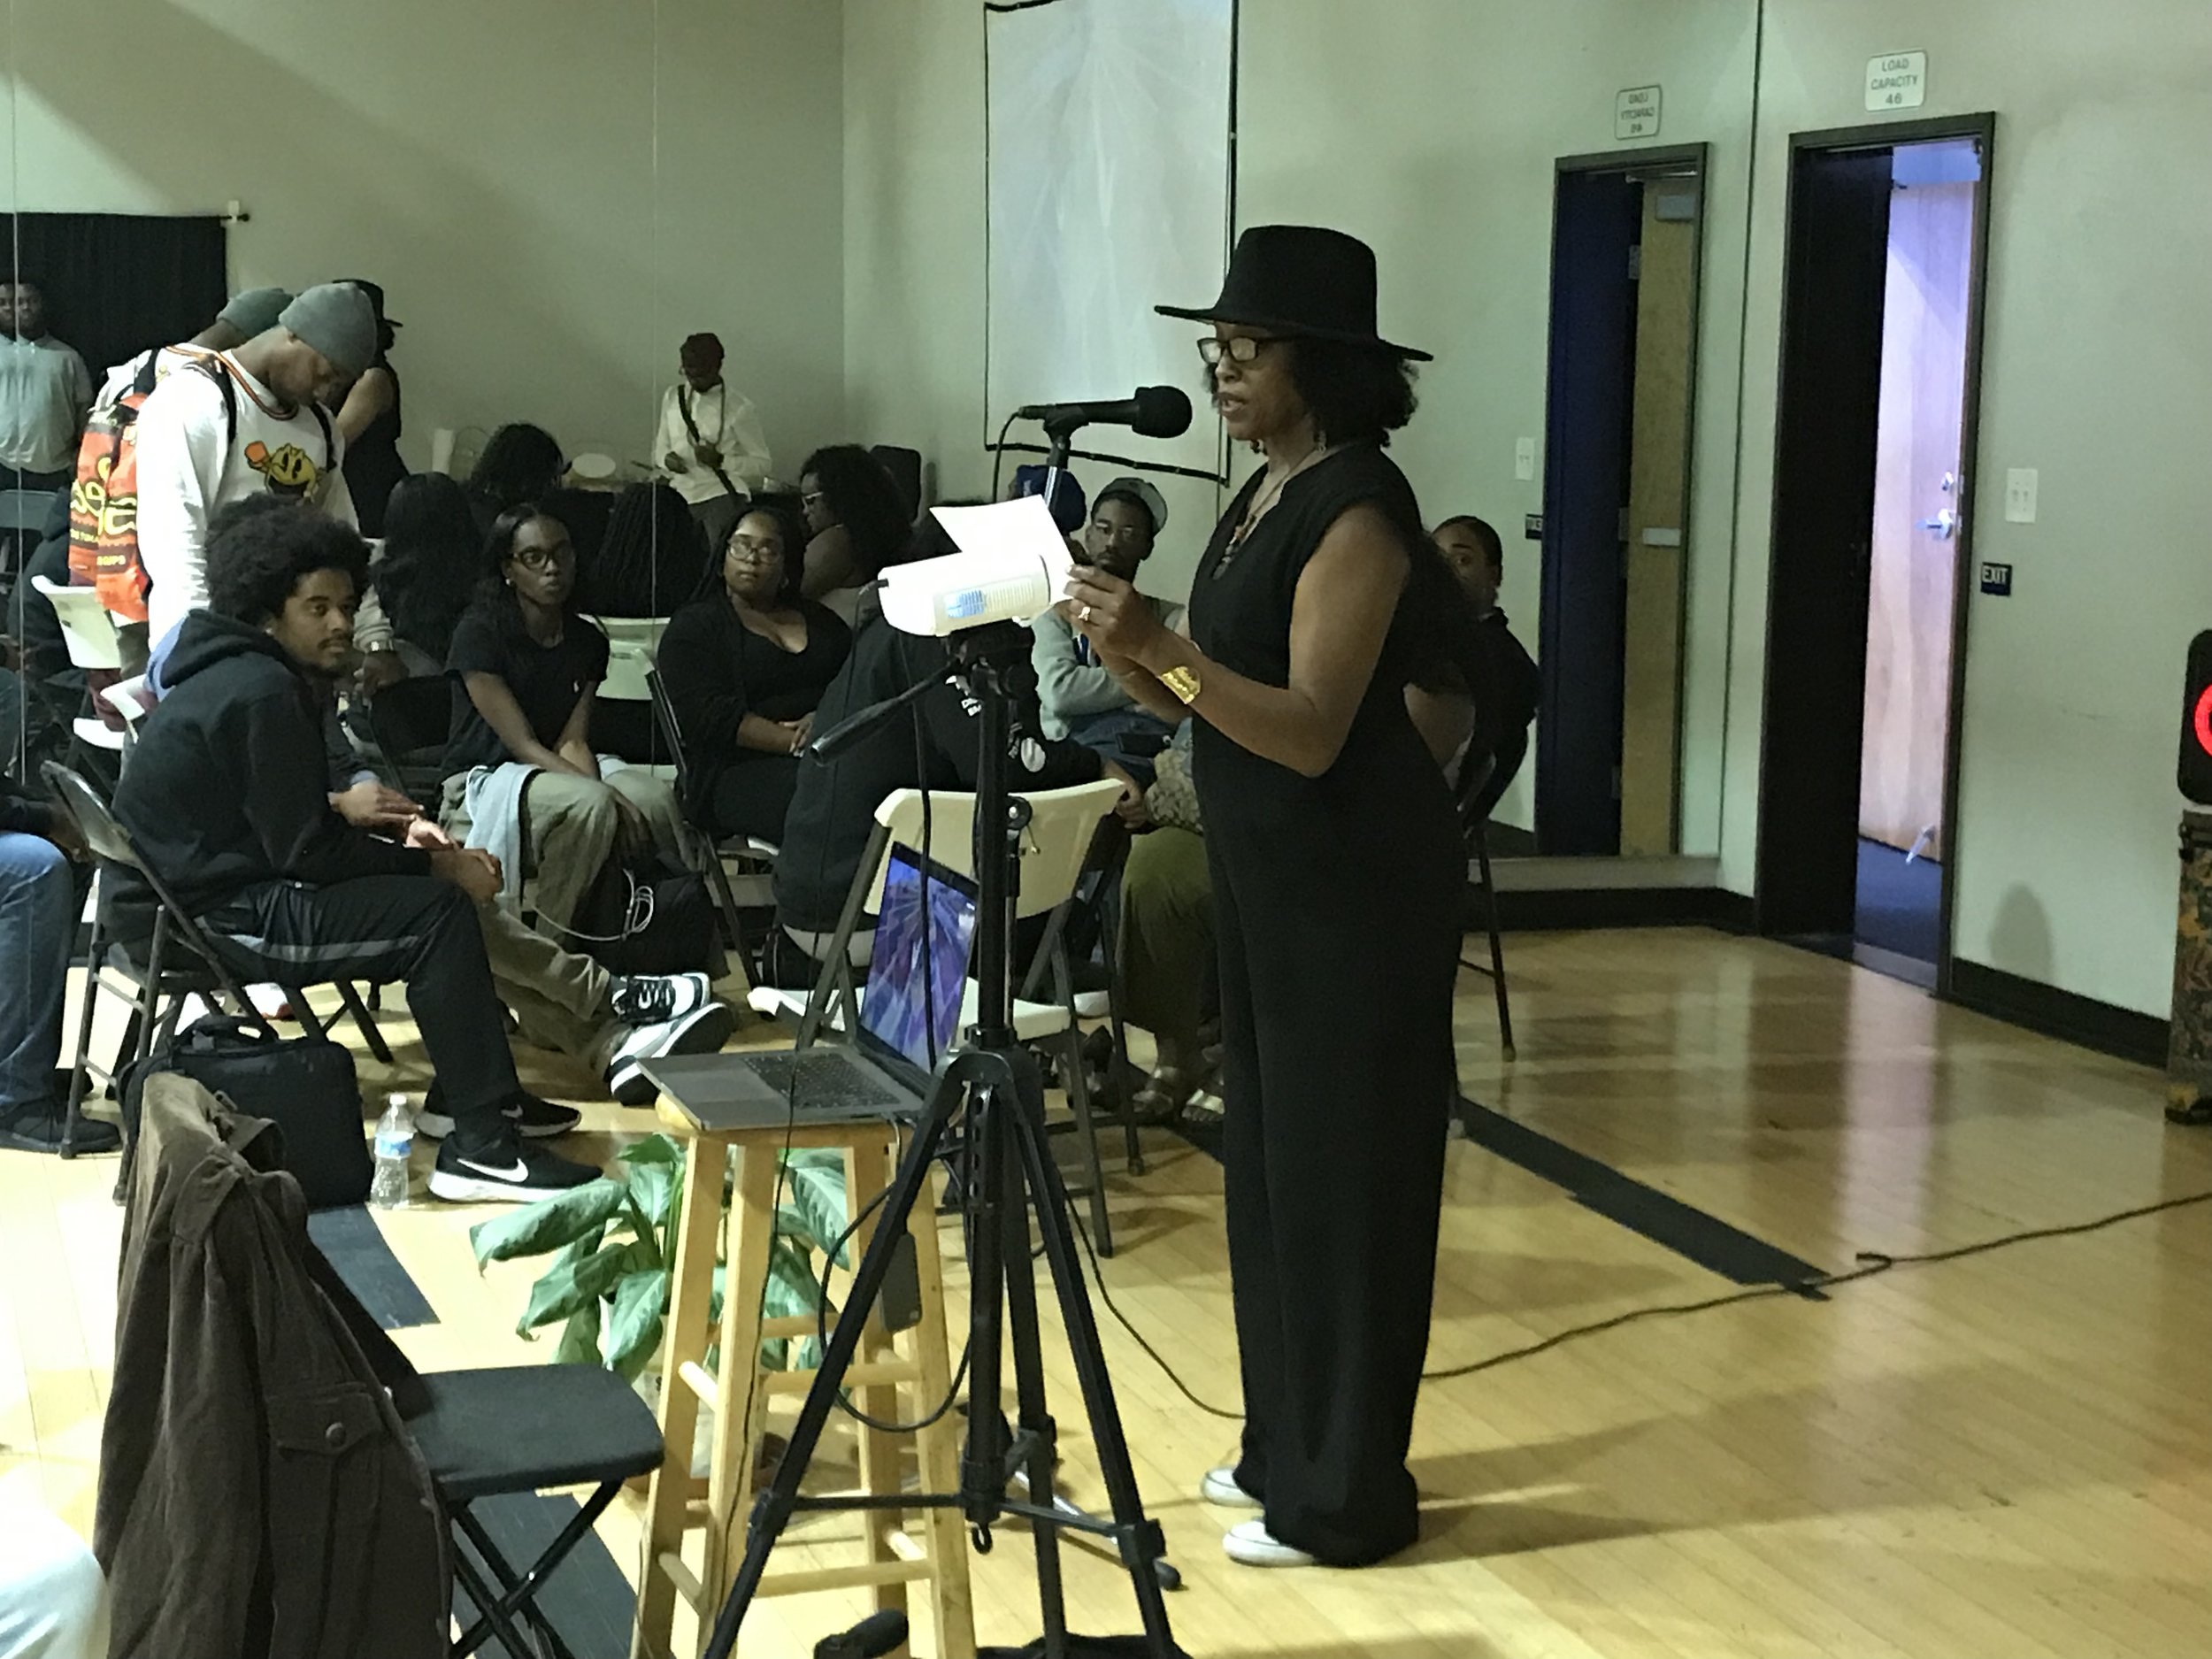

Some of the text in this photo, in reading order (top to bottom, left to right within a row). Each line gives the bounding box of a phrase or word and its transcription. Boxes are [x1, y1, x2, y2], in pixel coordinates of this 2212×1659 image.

[1882, 58, 1909, 72] LOAD
[1870, 74, 1918, 90] CAPACITY
[1885, 92, 1902, 104] 46
[1982, 565, 2008, 585] EXIT
